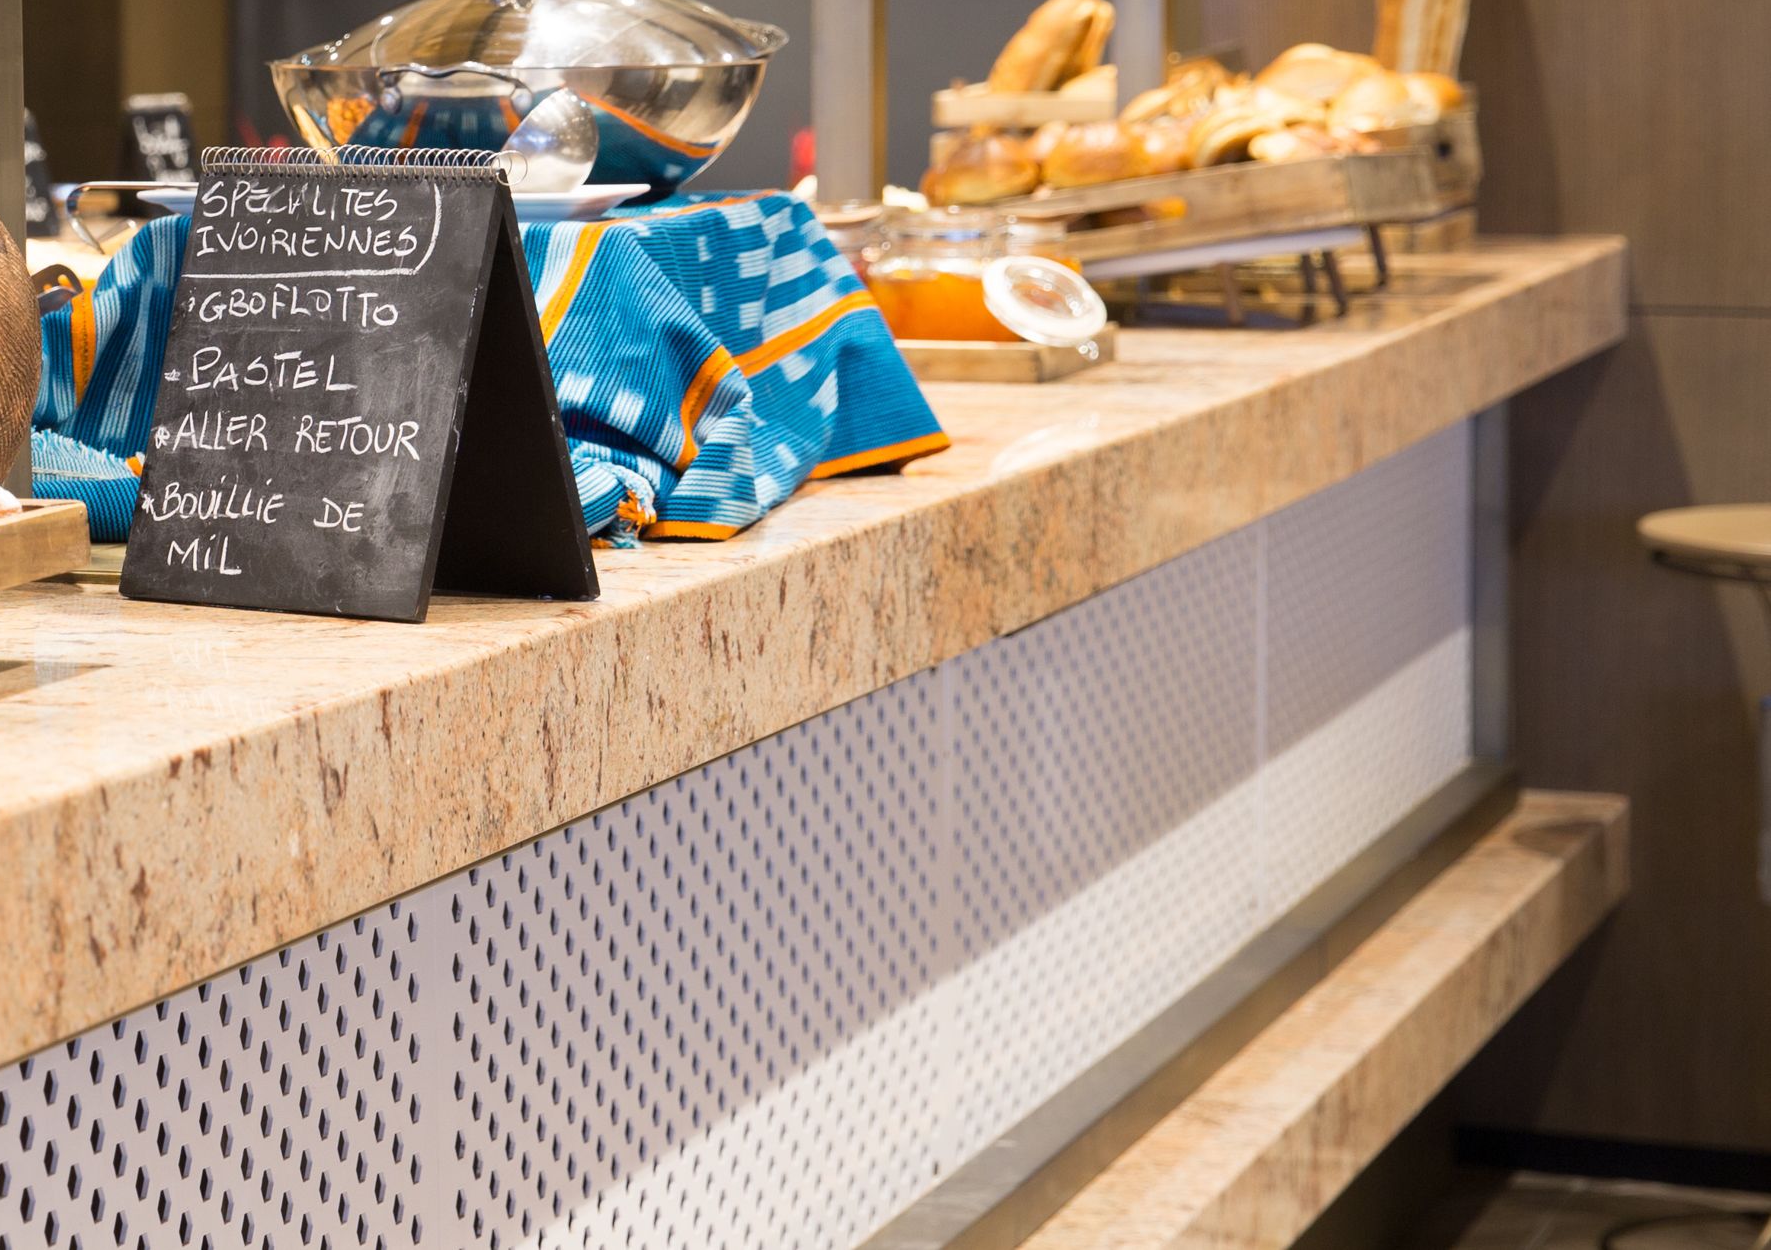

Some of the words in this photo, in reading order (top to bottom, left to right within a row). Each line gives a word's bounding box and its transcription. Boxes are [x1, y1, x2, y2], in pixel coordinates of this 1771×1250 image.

[198, 282, 400, 328] GBOFLOTTO
[185, 346, 359, 393] PASTEL
[172, 410, 269, 452] ALLER
[294, 414, 421, 462] RETOUR
[313, 496, 365, 533] DE
